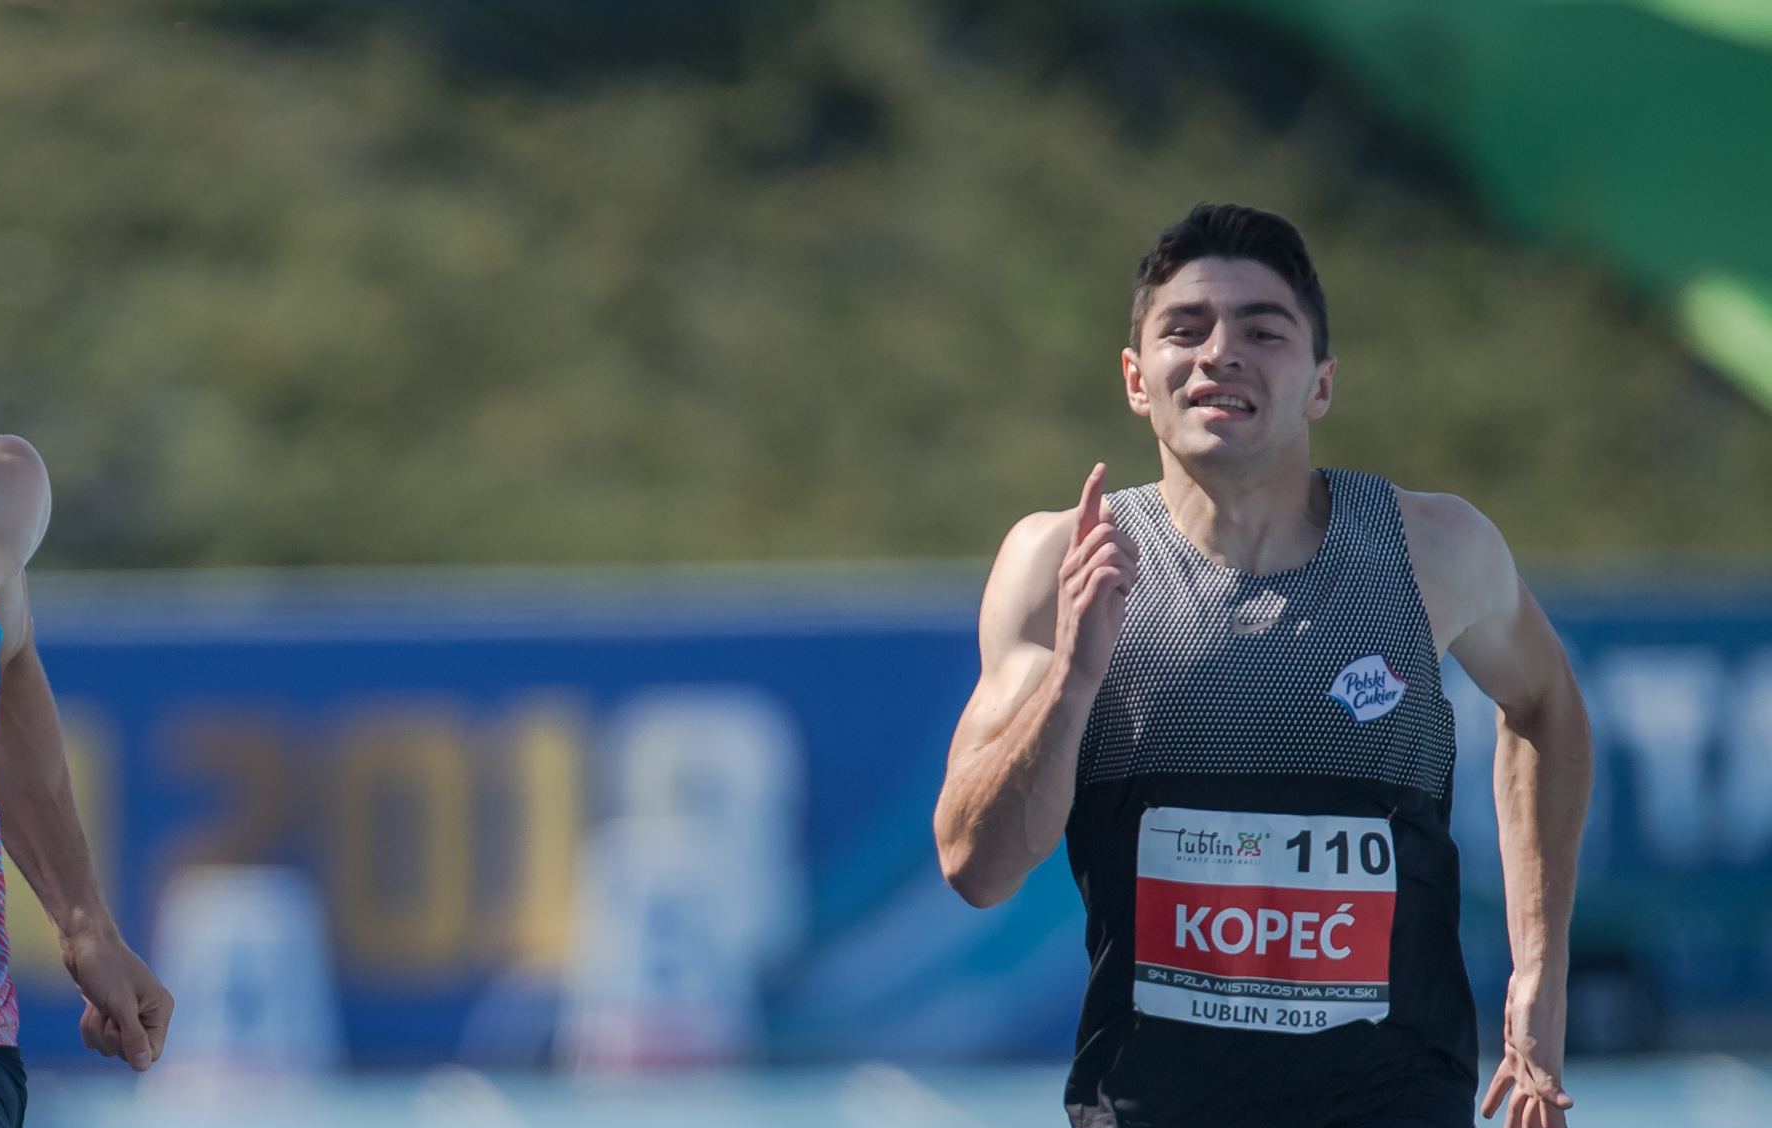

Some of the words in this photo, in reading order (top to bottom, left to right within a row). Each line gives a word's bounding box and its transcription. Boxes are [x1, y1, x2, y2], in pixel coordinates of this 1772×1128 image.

[1343, 669, 1386, 695] Polski
[1353, 689, 1399, 709] Cukier
[1150, 827, 1233, 856] lublin
[1285, 829, 1392, 875] 110
[1175, 903, 1356, 960] KOPEĆ
[1148, 969, 1171, 982] 94.
[1174, 972, 1211, 990] PZLA
[1214, 982, 1322, 998] MISTRZOSTWA
[1325, 987, 1378, 999] POLSKI
[1191, 1000, 1268, 1024] LUBLIN
[1275, 1008, 1328, 1027] 2018
